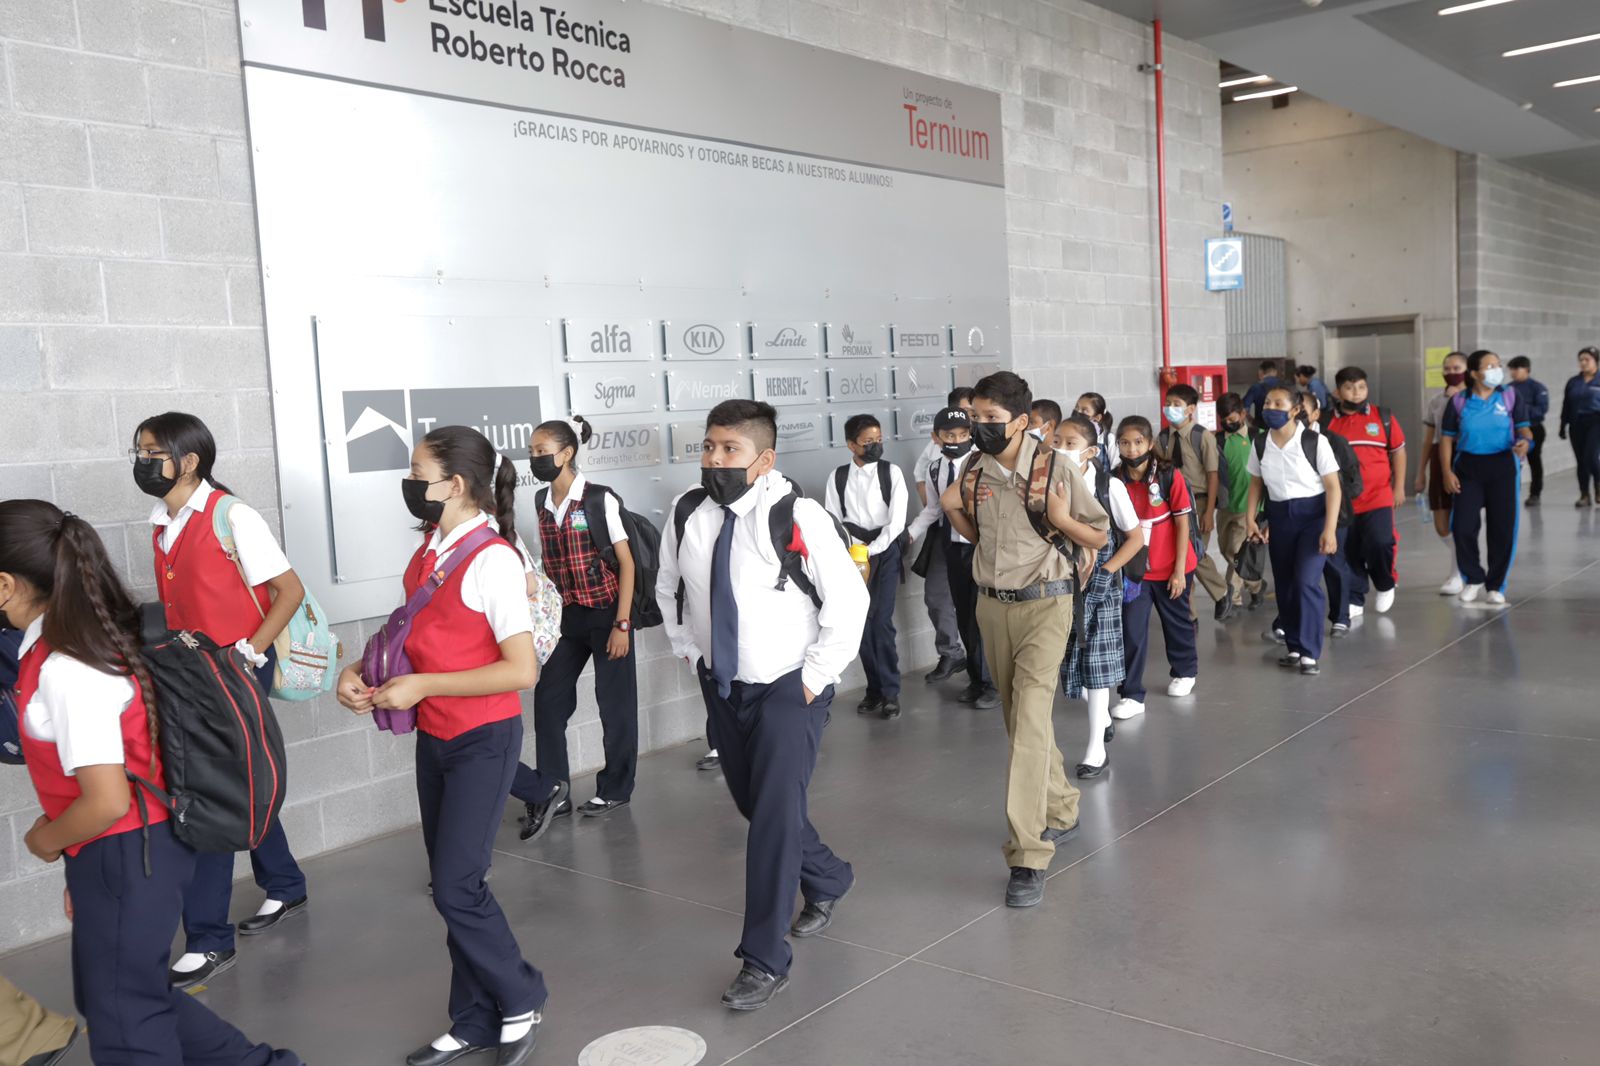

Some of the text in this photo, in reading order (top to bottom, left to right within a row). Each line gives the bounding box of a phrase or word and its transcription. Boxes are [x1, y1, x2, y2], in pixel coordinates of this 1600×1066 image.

[540, 6, 631, 53] Técnica
[430, 22, 626, 88] Roberto Rocca
[903, 103, 989, 161] Ternium
[513, 120, 894, 188] ¡GRACIAS POR APOYARNOS Y OTORGAR BECAS A NUESTROS ALUMNOS!
[590, 324, 632, 353] alfa
[690, 331, 718, 348] KIA
[765, 327, 808, 347] Linde
[900, 333, 940, 347] FESTO
[842, 346, 872, 356] PROMAX
[594, 382, 636, 409] Sigma
[690, 380, 738, 399] Nemak
[840, 373, 878, 396] axtel
[587, 429, 651, 451] DENSO
[587, 454, 619, 466] Crafting
[619, 452, 633, 463] the
